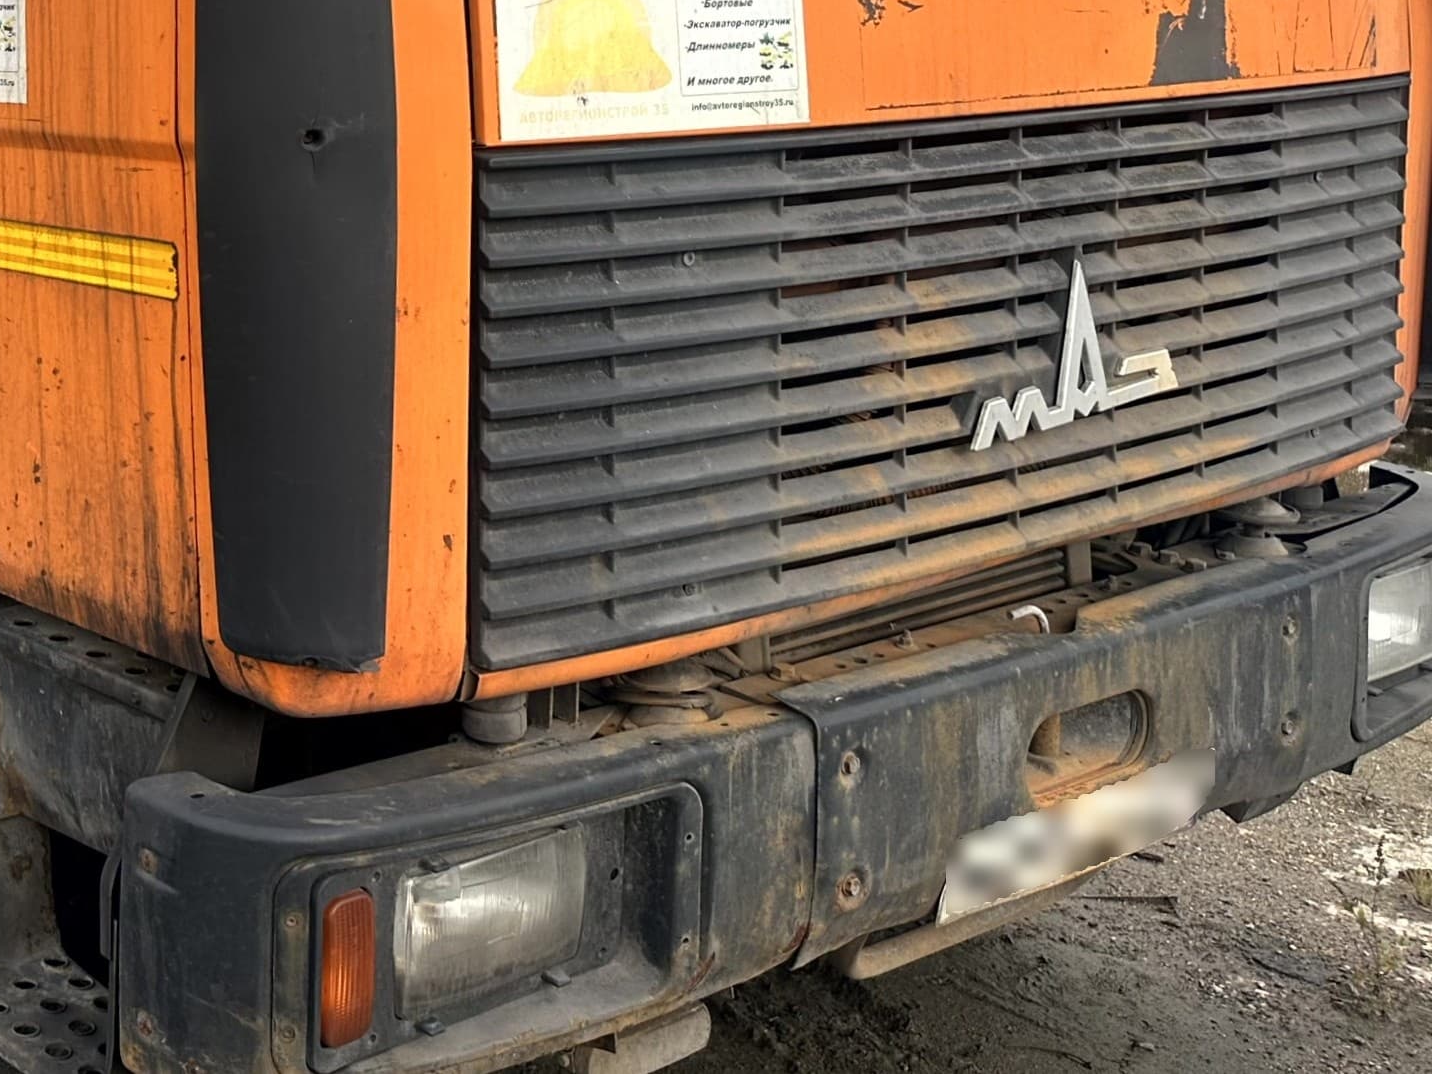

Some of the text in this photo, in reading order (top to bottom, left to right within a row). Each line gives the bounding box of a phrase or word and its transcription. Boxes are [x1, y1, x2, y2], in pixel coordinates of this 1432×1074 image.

[683, 17, 791, 28] -Экскаватор-погрузчик
[687, 74, 774, 87] И многое другое.
